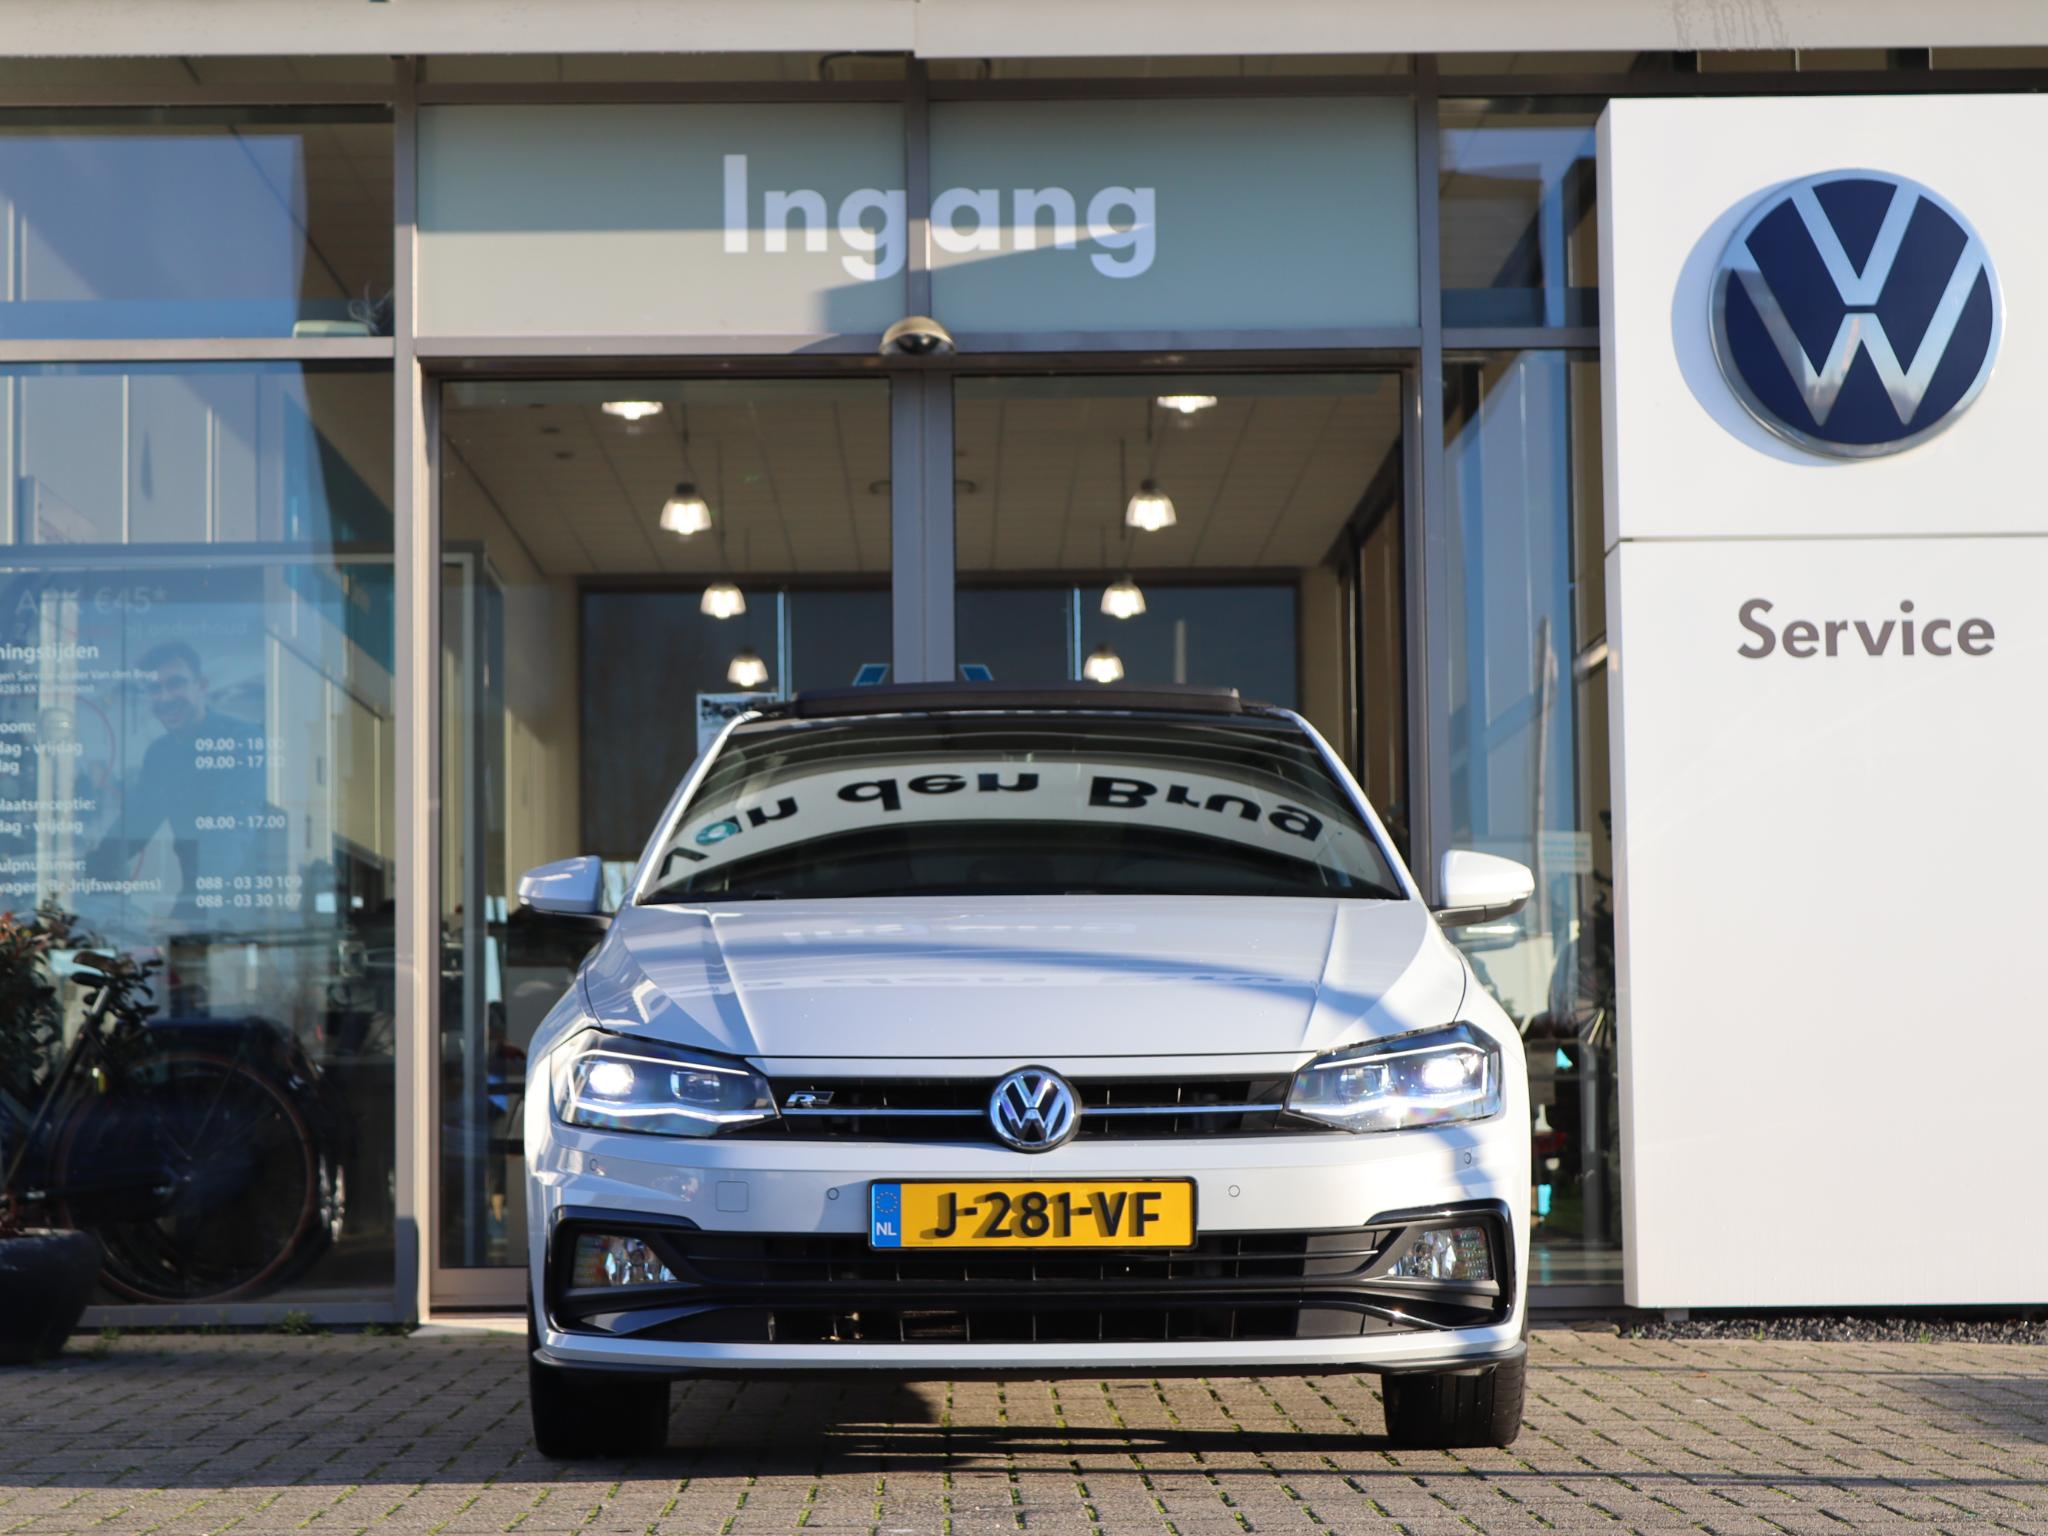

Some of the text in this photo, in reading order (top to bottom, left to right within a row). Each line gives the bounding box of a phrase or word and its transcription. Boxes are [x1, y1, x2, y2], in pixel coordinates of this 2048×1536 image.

[724, 154, 1156, 280] Ingang
[1736, 598, 1996, 660] Service
[195, 737, 235, 752] 09.00
[195, 755, 235, 770] 09.00
[195, 815, 235, 830] 08.00
[247, 815, 286, 829] 17.00
[196, 876, 223, 890] 088
[233, 876, 252, 890] 03
[255, 875, 273, 889] 30
[196, 894, 223, 908] 088
[233, 894, 252, 908] 03
[255, 893, 273, 907] 30
[876, 1191, 1163, 1238] NL J-281-VF
